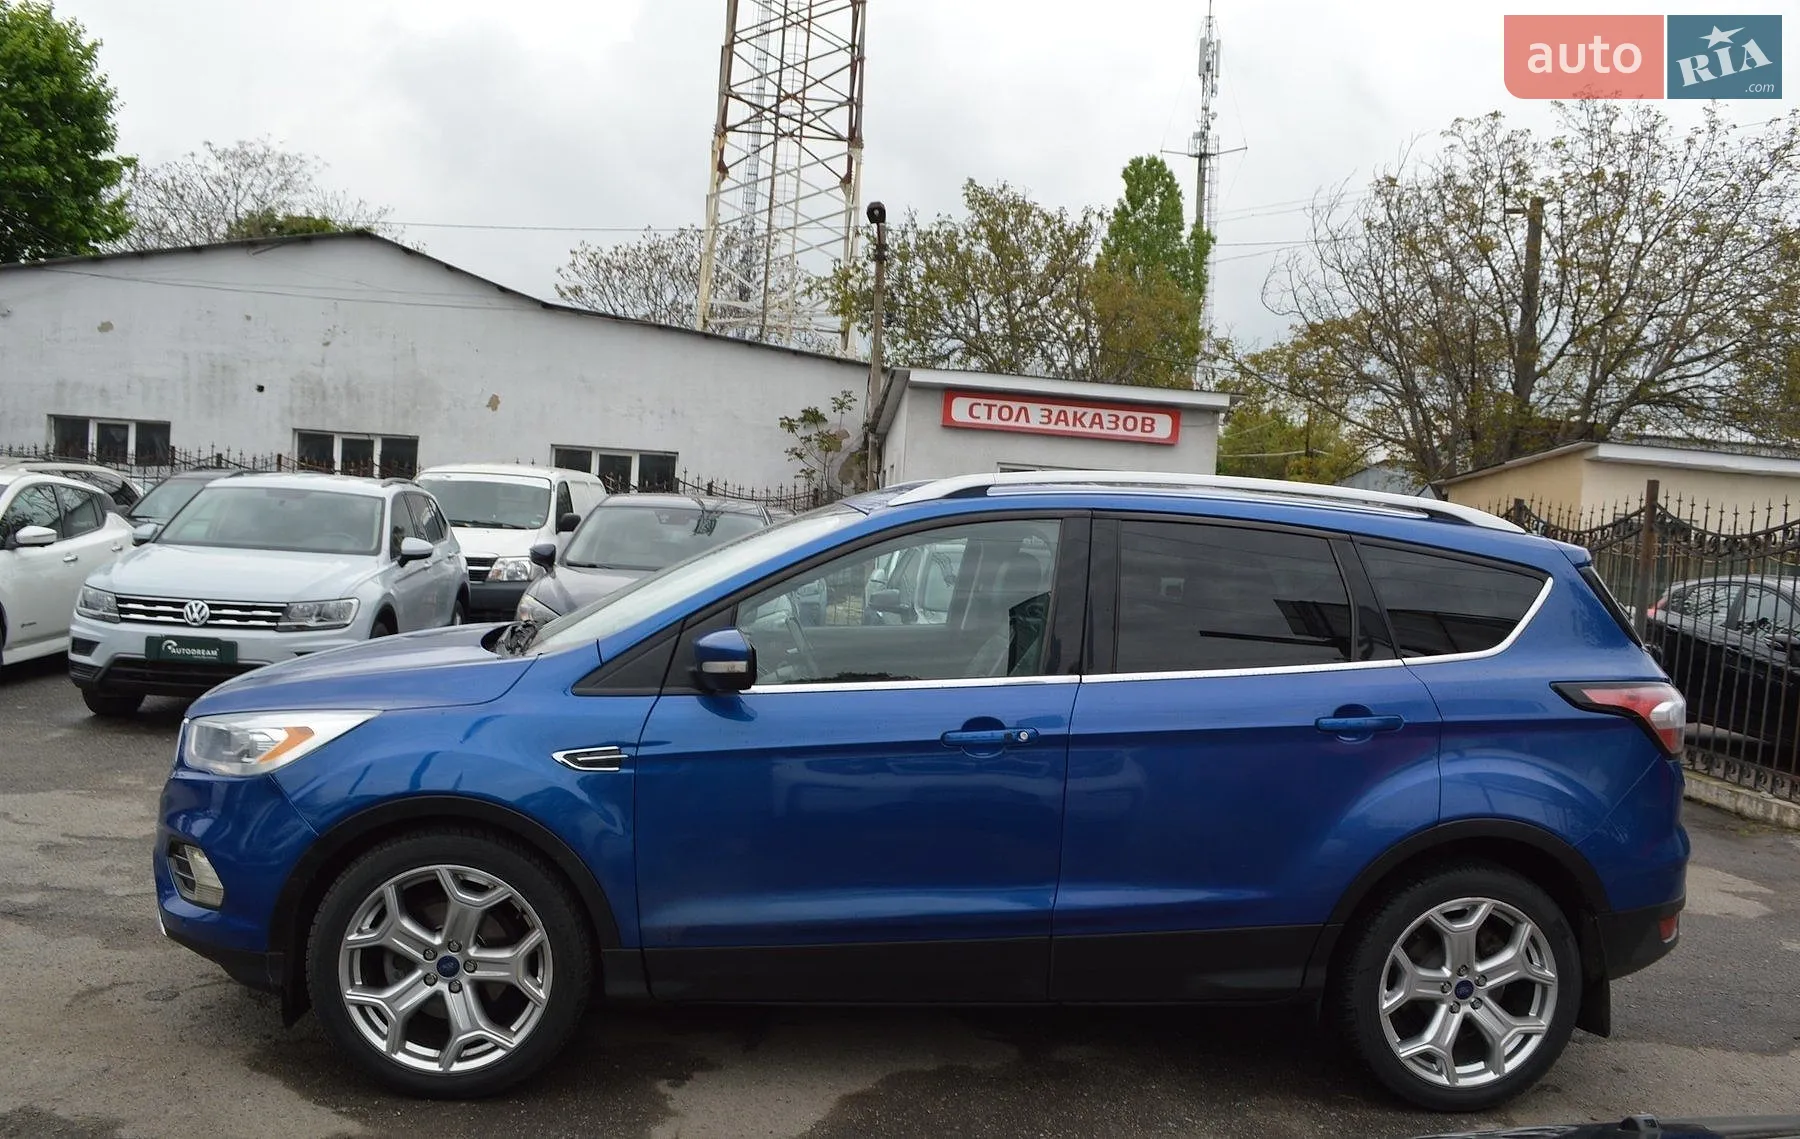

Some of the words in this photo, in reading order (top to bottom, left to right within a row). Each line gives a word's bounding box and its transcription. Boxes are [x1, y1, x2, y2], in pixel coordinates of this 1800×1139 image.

[967, 402, 1031, 424] СТОЛ
[1039, 408, 1156, 434] ЗАКАЗОВ
[170, 647, 218, 657] AUTODREAM
